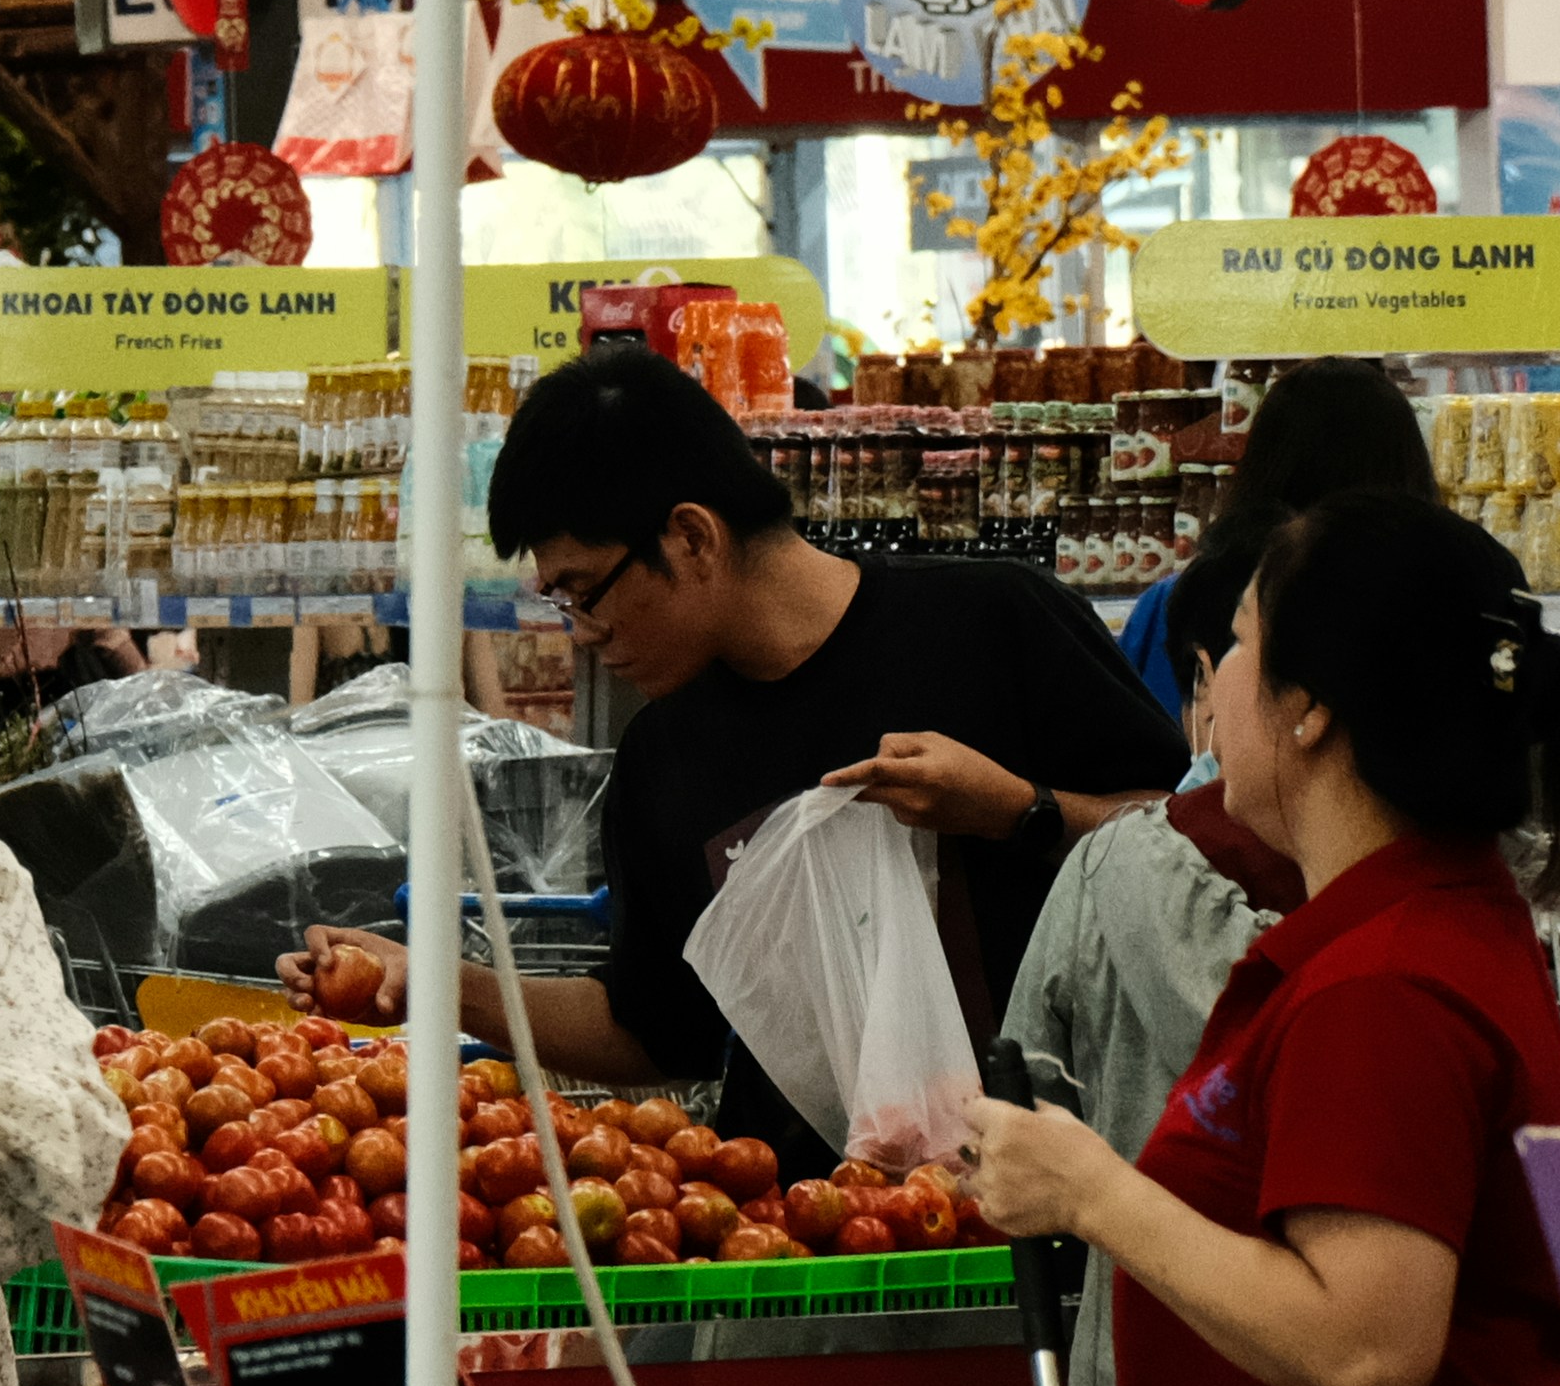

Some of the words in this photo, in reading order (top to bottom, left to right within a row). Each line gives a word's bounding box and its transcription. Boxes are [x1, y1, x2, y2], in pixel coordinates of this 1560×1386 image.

[1222, 246, 1282, 273] RAU
[1294, 237, 1333, 273] CỦ
[1346, 233, 1441, 271] ĐÔNG
[1452, 244, 1535, 277] LẠNH
[2, 291, 94, 317] KHOAI
[103, 287, 153, 316] TÂY
[162, 283, 248, 315] ĐÔNG
[261, 291, 336, 321] LẠNH
[1293, 291, 1359, 310] Frozen
[1365, 288, 1467, 314] Vegetables
[115, 333, 174, 352] French
[181, 332, 224, 352] Fries
[533, 326, 567, 349] Ice
